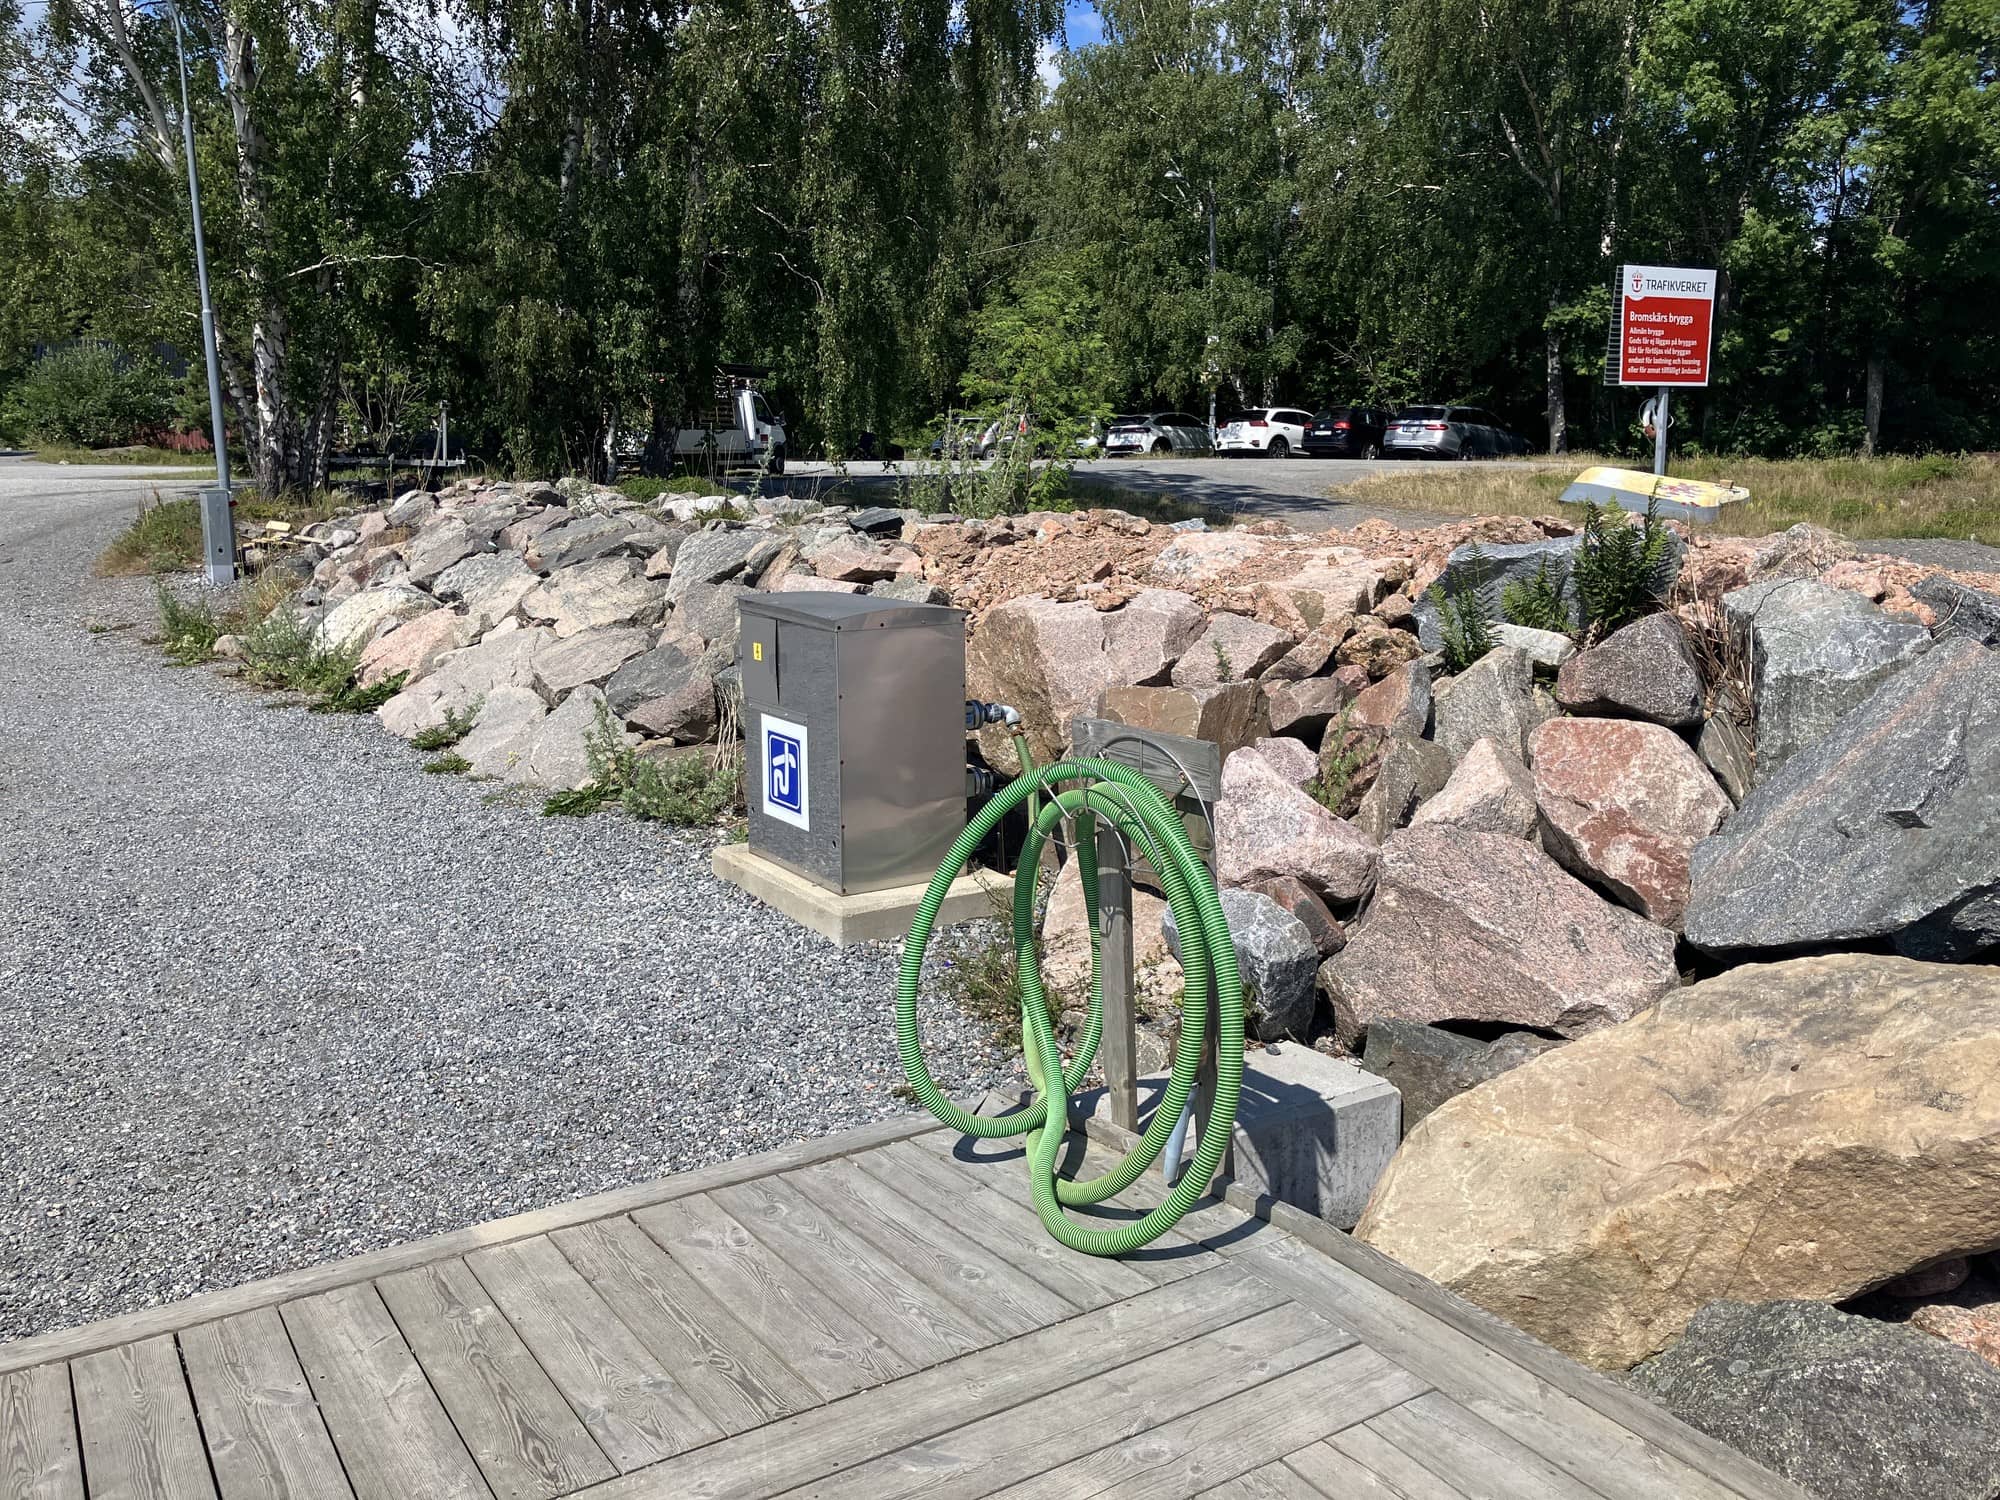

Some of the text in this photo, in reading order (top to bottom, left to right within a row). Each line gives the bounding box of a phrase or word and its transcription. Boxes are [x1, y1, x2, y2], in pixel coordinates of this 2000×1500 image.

[1646, 279, 1708, 293] TRAFIKVERKET
[1630, 311, 1693, 326] Bromskärs brygga
